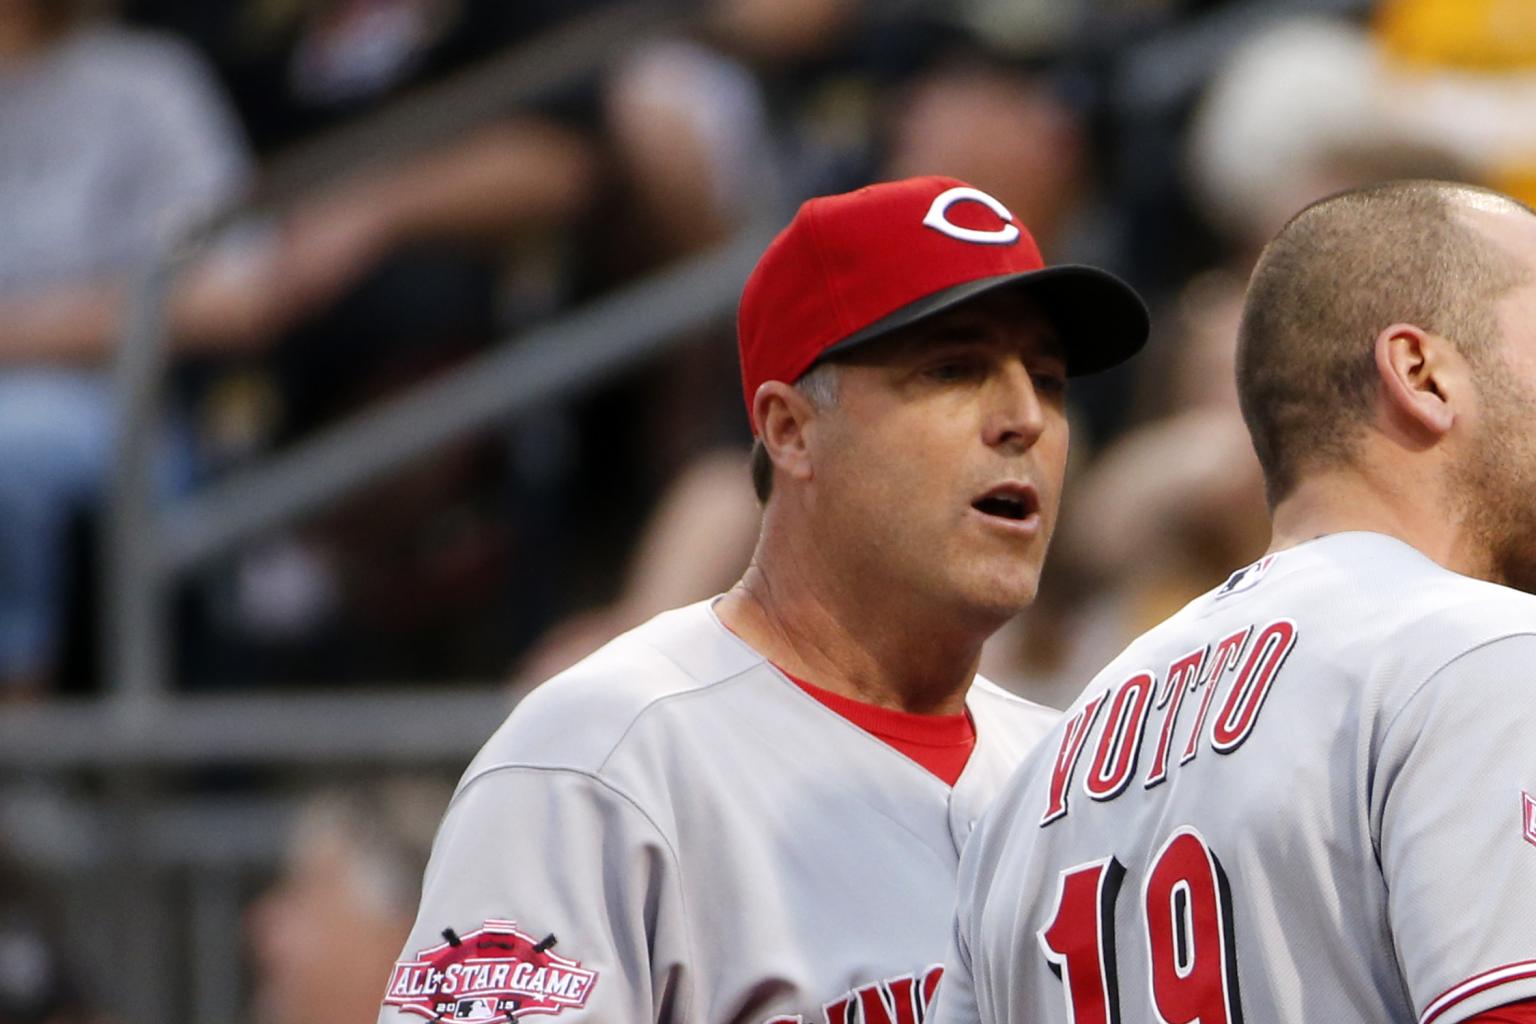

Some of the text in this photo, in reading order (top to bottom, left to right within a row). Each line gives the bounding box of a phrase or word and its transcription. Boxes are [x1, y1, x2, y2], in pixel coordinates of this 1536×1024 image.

[922, 187, 1020, 245] C
[1040, 617, 1297, 828] VOTTO
[511, 962, 587, 999] GAME
[436, 1001, 456, 1013] 20
